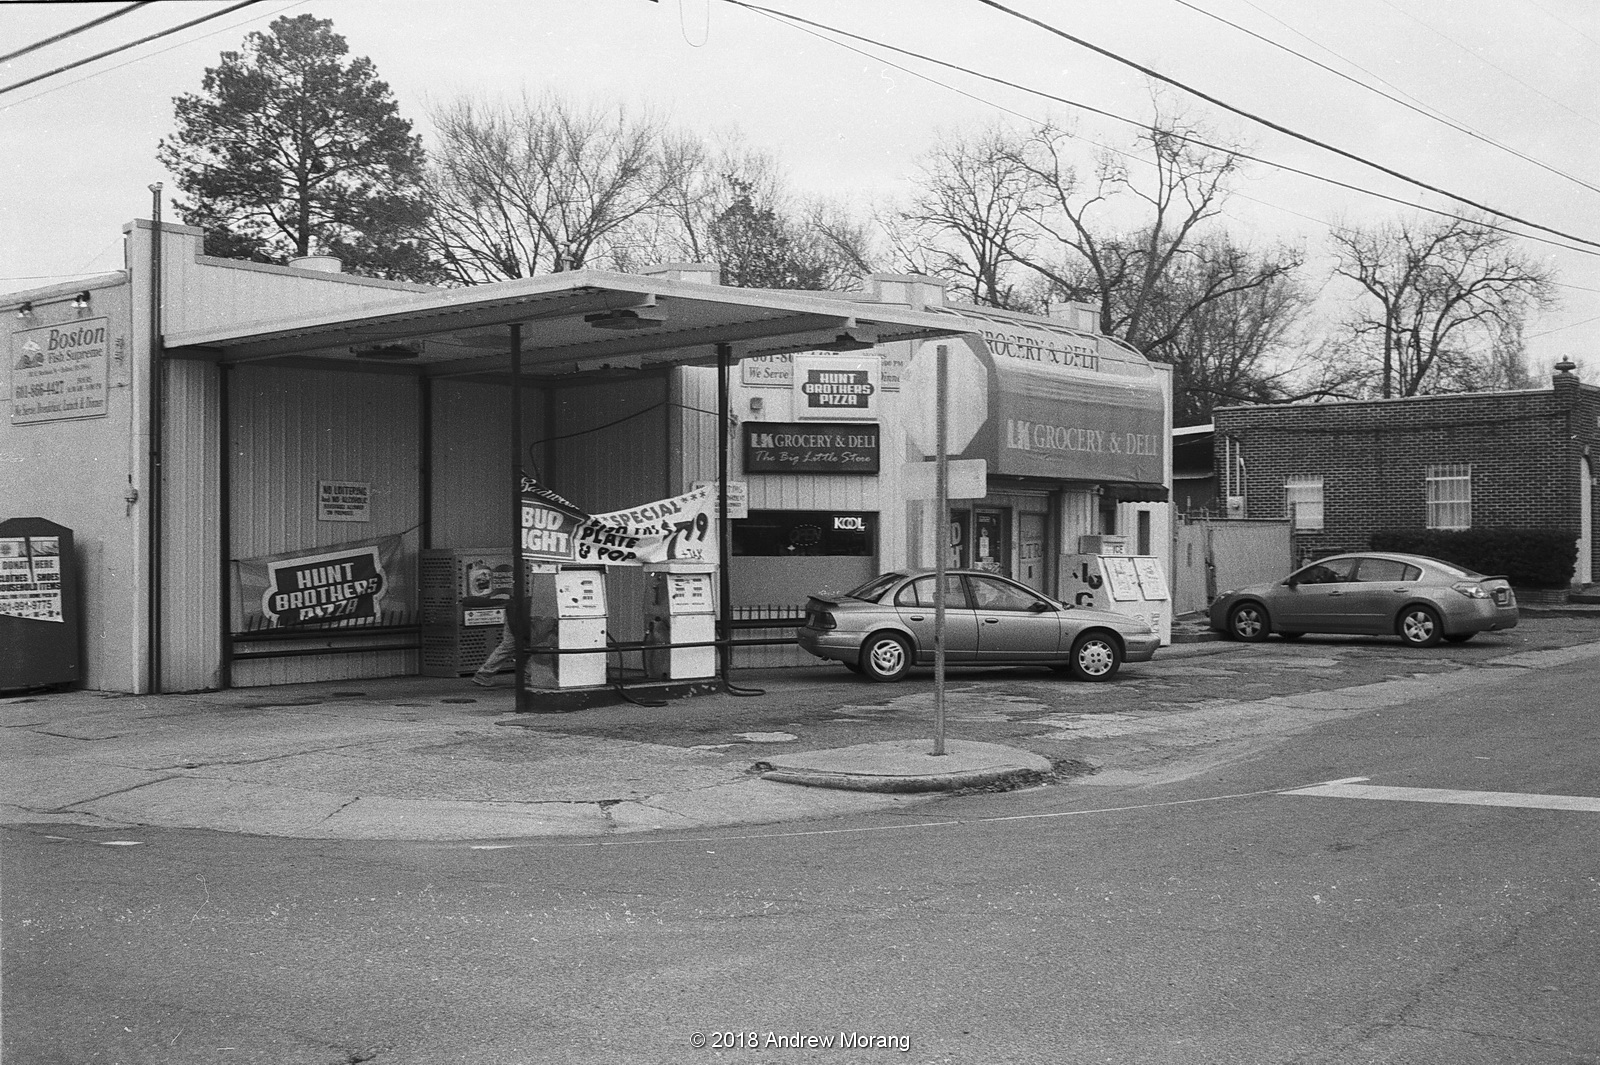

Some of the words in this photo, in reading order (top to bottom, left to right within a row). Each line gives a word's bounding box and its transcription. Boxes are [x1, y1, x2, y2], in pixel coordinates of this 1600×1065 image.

[48, 327, 105, 351] Boston
[978, 329, 1044, 361] ROCERY
[1064, 344, 1094, 369] DELI
[763, 367, 789, 380] Serve
[820, 373, 857, 384] HUNT
[806, 383, 871, 395] BROTHERS
[820, 394, 857, 405] PIZZA
[775, 434, 833, 448] GROCERY
[835, 434, 846, 448] &
[848, 435, 876, 448] DELI
[1034, 424, 1105, 453] GROCERY
[1110, 432, 1122, 454] &
[1126, 433, 1158, 456] DELI
[755, 450, 776, 462] The
[779, 451, 799, 465] Big
[841, 451, 871, 463] Store
[323, 485, 333, 494] NO
[521, 506, 564, 530] BUD
[610, 500, 683, 527] SPECIAL
[834, 517, 865, 529] KOOL
[521, 528, 568, 552] IGHT
[580, 526, 640, 548] PLATE
[597, 547, 636, 562] POP
[296, 562, 355, 589] HUNT
[275, 577, 378, 612] BROTHERS
[299, 598, 359, 621] PIZZA
